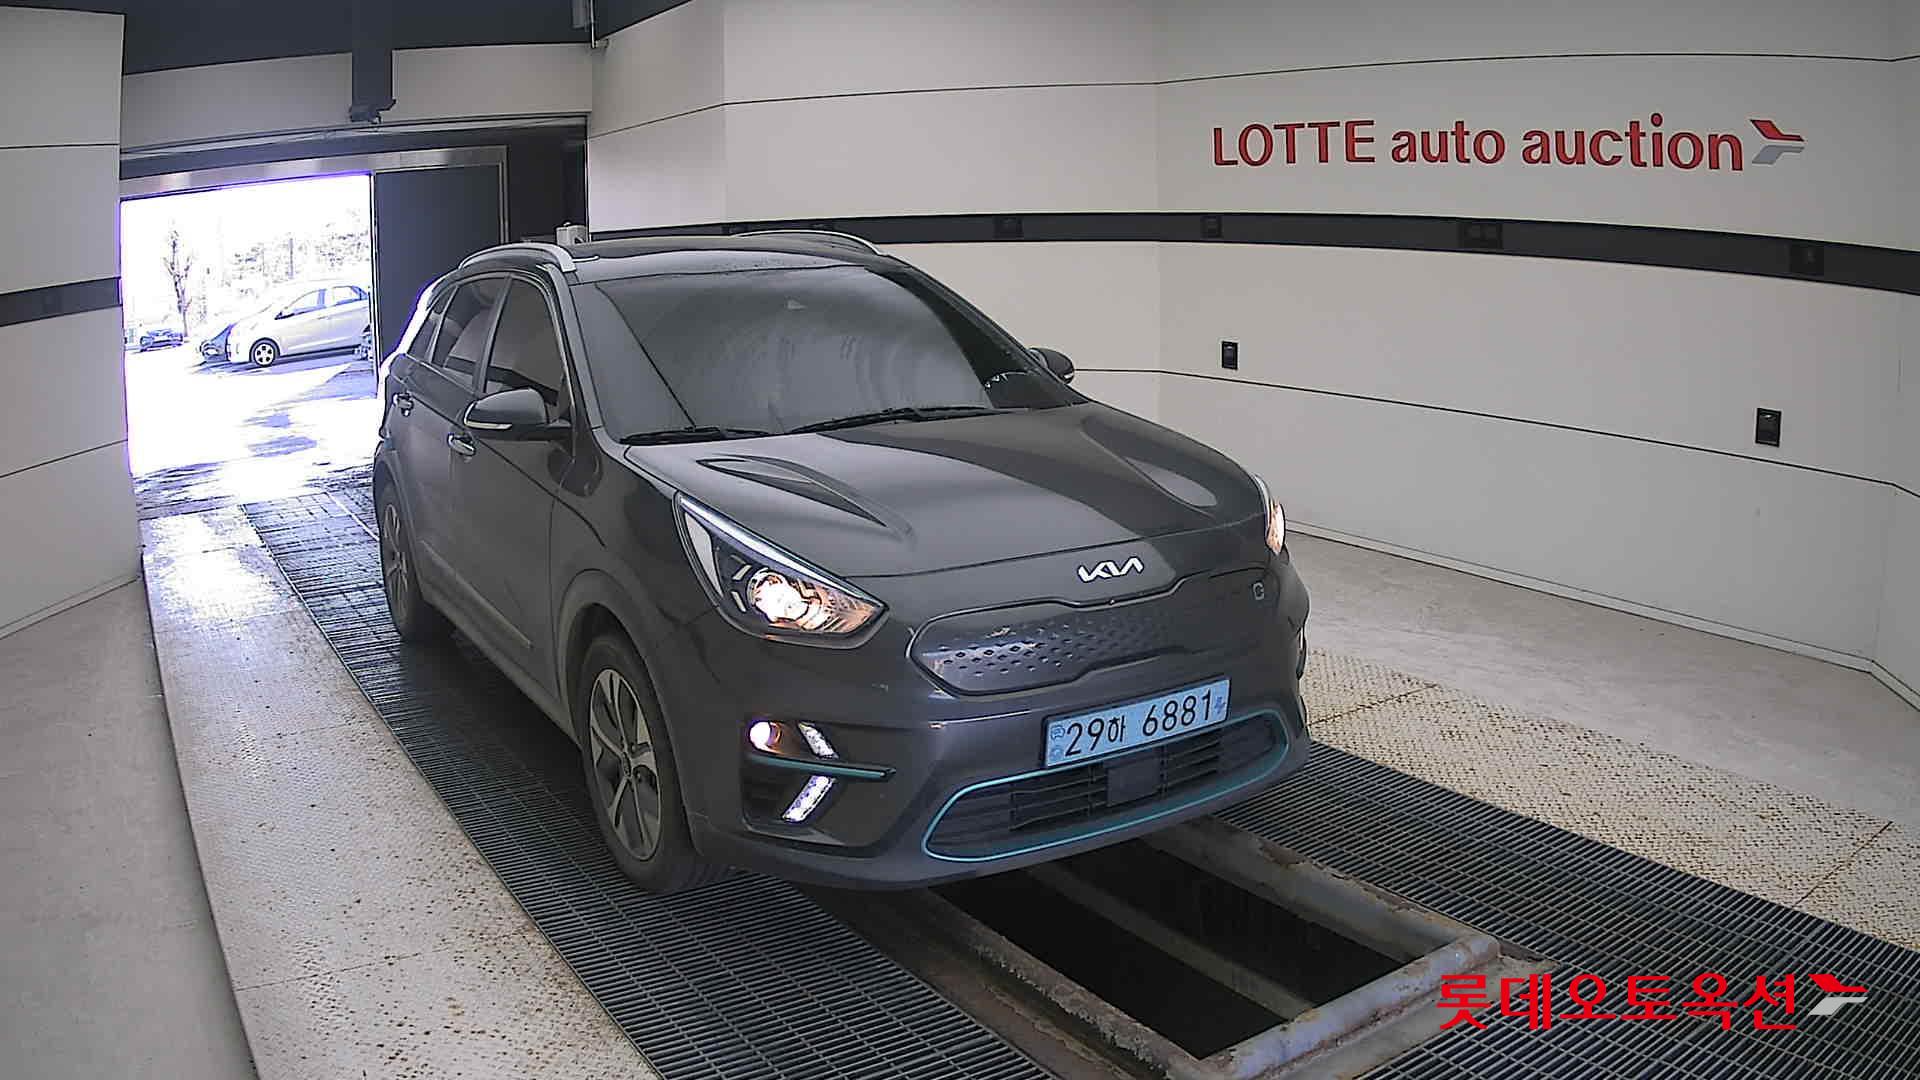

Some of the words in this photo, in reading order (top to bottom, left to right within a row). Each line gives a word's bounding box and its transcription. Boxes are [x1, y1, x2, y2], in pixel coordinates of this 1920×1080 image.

[1213, 120, 1376, 166] LOTTE
[1391, 121, 1505, 164] auto
[1522, 113, 1743, 171] auction
[1077, 556, 1144, 583] KIA
[1065, 715, 1126, 756] 29하
[1142, 689, 1212, 736] 6881
